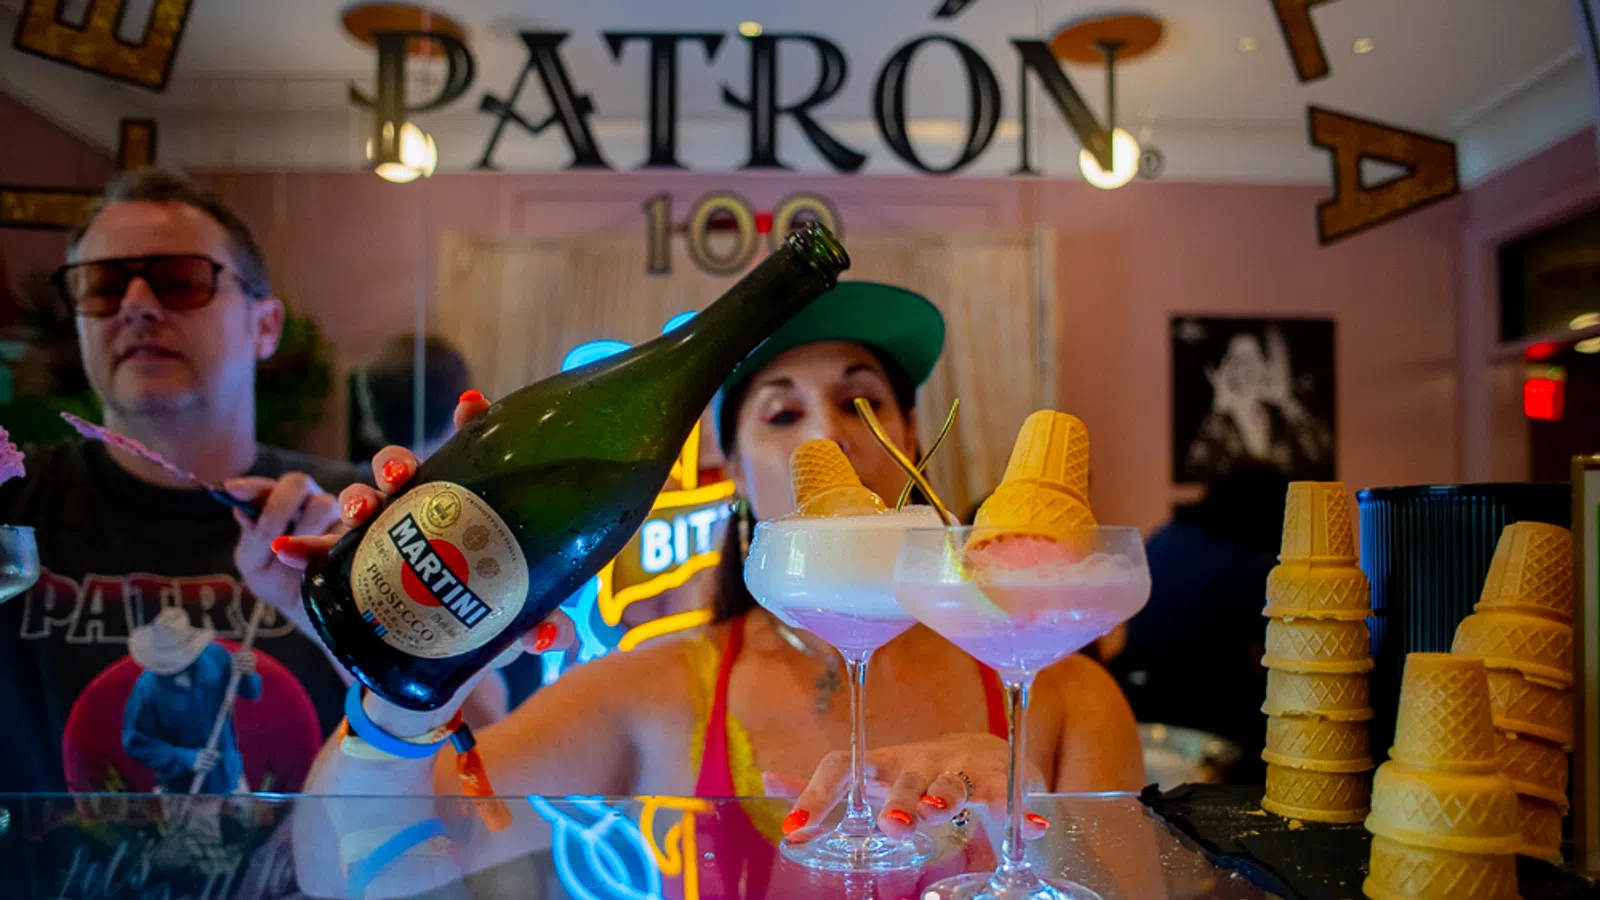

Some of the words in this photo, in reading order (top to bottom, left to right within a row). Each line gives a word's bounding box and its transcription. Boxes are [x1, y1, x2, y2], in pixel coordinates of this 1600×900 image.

[348, 0, 1123, 175] PATRÓN
[390, 517, 489, 626] MARTINI
[641, 503, 731, 574] BIT
[366, 563, 434, 641] PROSECCO
